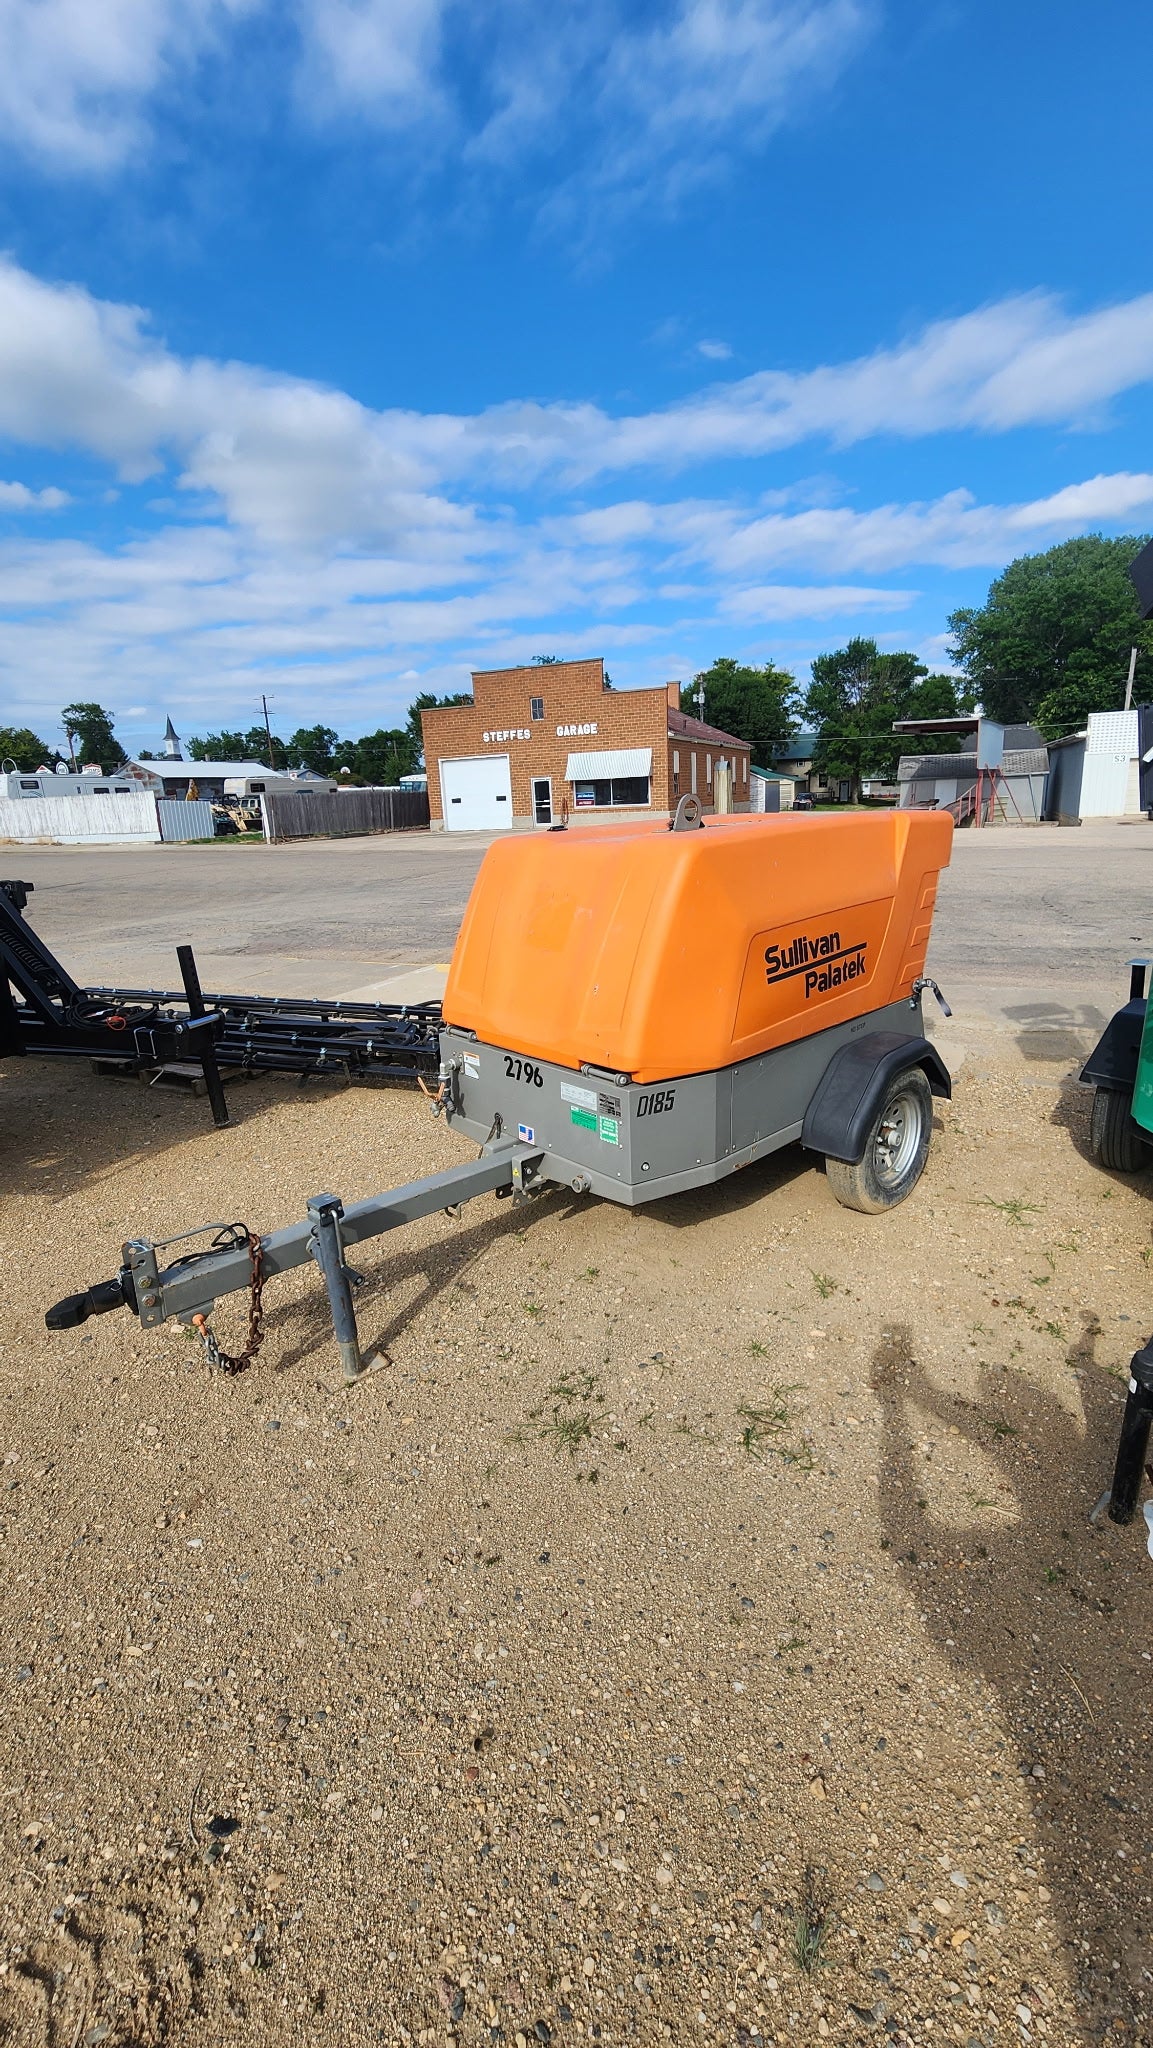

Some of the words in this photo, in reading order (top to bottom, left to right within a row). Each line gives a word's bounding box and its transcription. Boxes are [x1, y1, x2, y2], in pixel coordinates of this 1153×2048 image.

[482, 729, 532, 743] STEFFES
[556, 723, 598, 737] GARAGE
[764, 932, 841, 975] Sullivan
[804, 952, 866, 999] Palatek
[503, 1055, 544, 1088] 2796
[636, 1089, 676, 1118] D185
